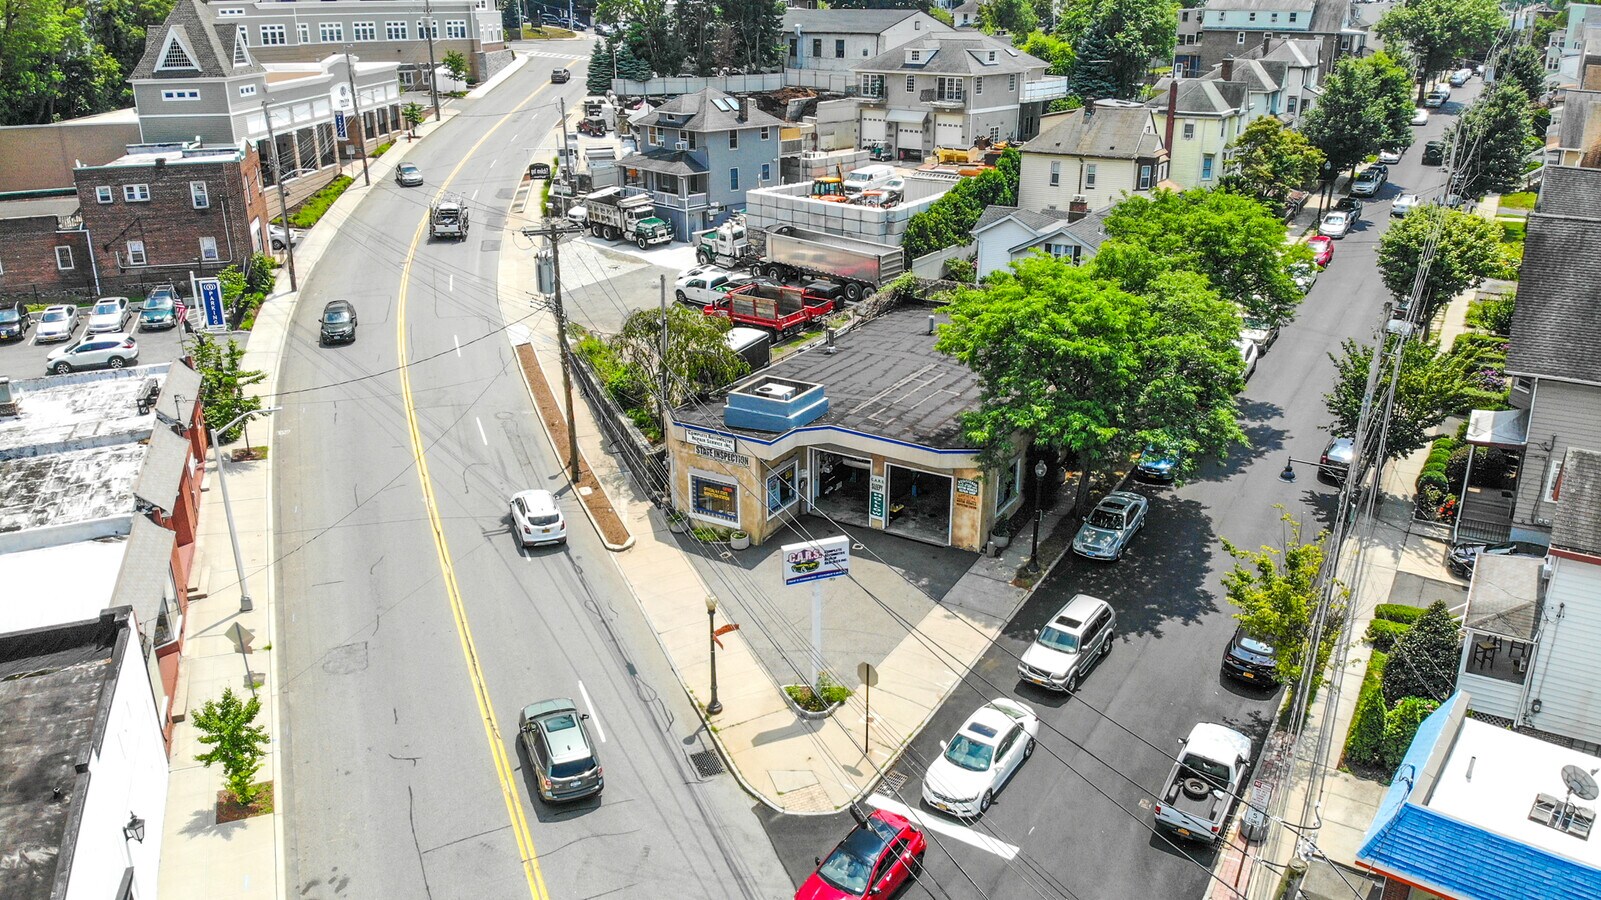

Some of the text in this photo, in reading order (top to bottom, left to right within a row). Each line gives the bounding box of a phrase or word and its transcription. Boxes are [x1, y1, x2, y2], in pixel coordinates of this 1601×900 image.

[208, 291, 219, 325] PARKING
[714, 450, 749, 466] INSPECTION
[788, 549, 822, 563] C.A.R.S.
